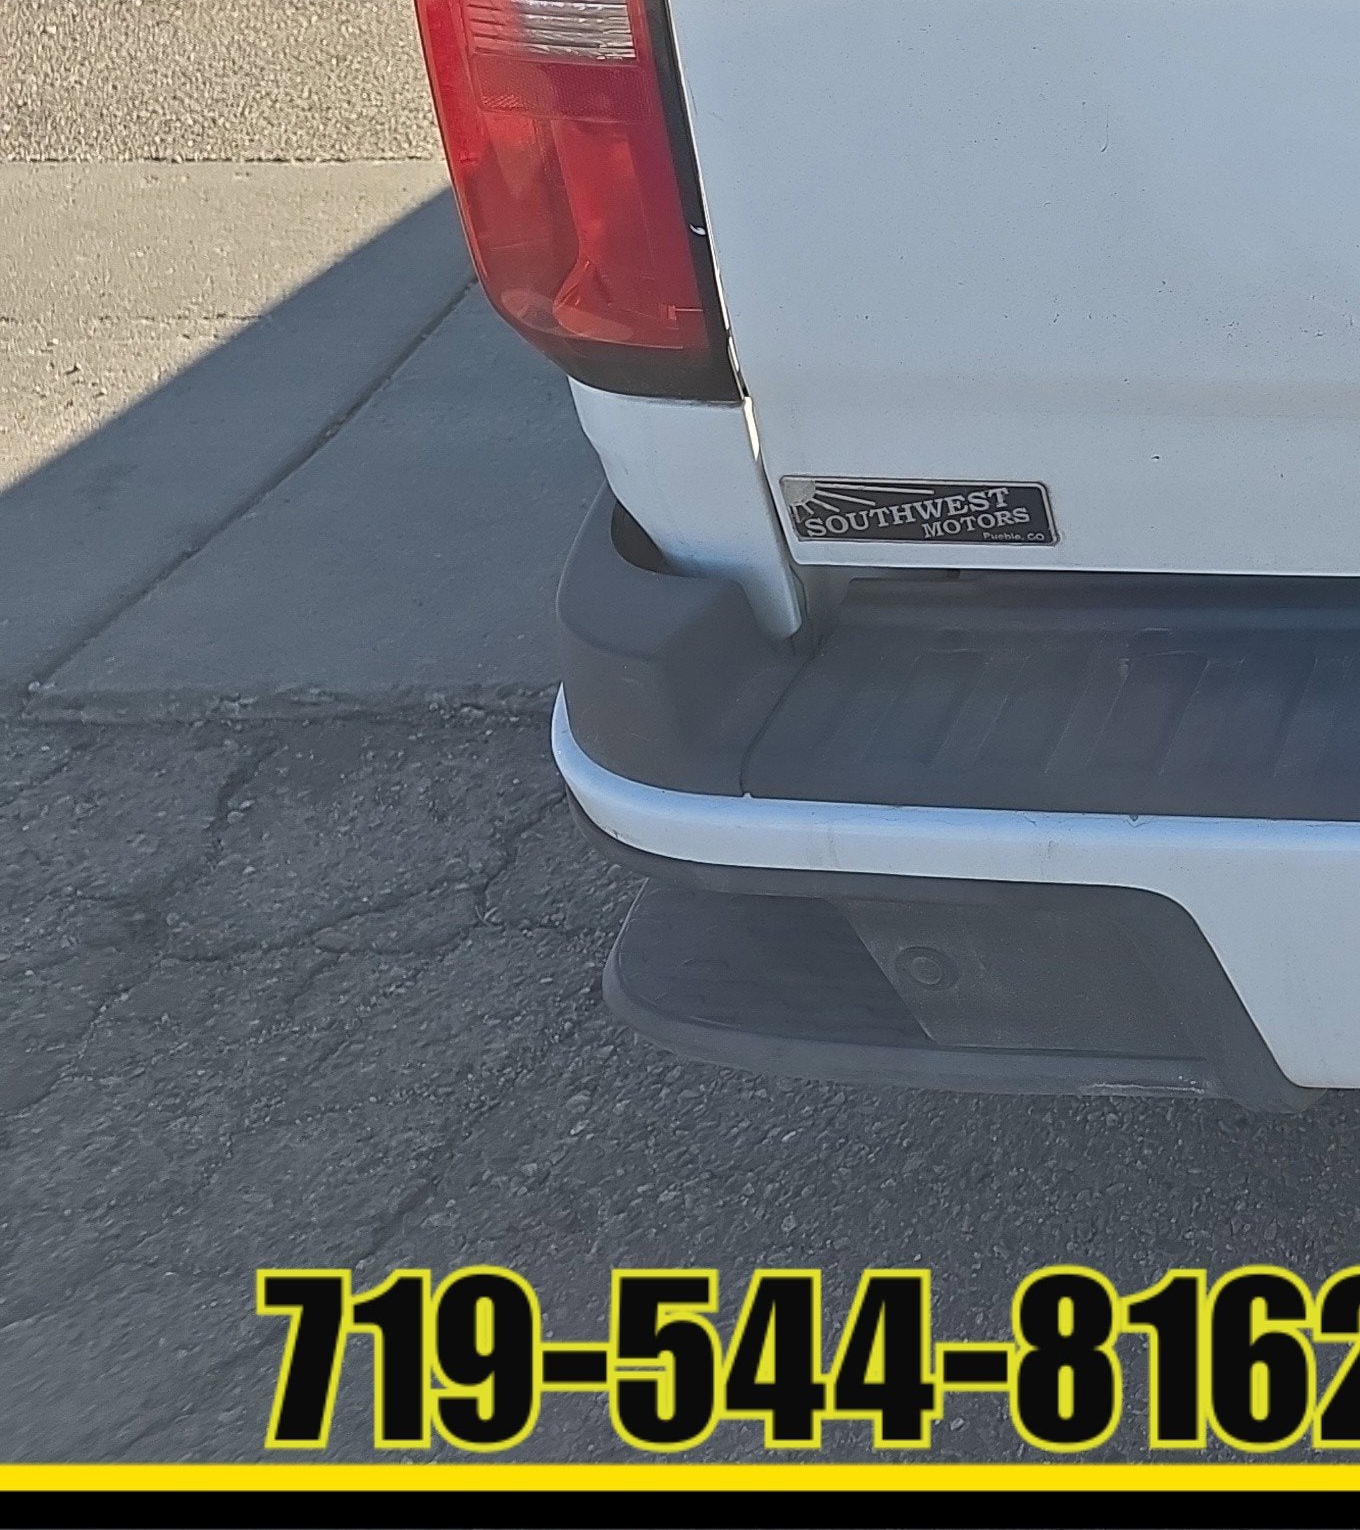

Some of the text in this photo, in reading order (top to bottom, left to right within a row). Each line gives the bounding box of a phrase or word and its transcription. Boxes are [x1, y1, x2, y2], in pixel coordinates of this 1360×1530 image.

[805, 487, 1010, 537] SOUTHWEST
[922, 507, 1030, 539] MOTORS
[1027, 532, 1045, 541] CO
